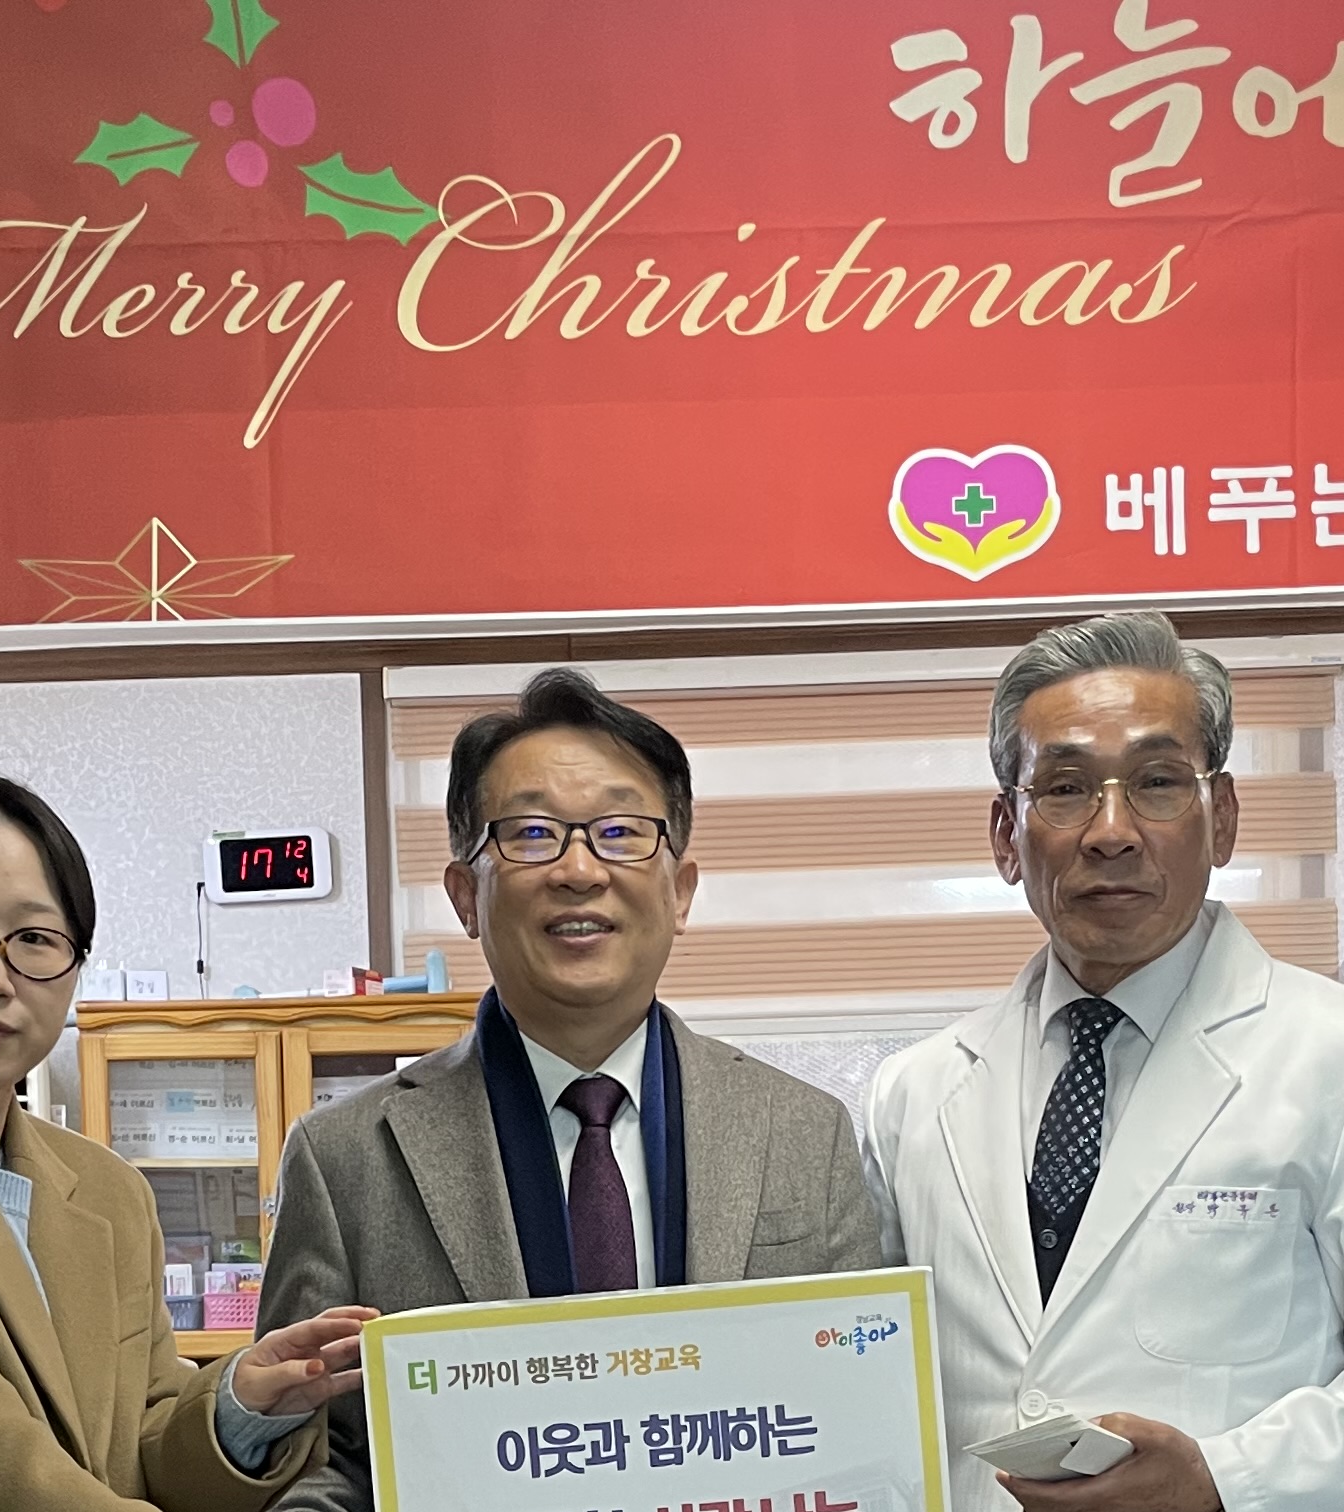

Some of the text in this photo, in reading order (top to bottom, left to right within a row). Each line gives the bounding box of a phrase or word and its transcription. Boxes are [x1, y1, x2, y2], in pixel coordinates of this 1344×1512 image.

[396, 132, 1198, 353] Christmas
[285, 840, 307, 859] 12
[296, 867, 309, 884] 4
[815, 1321, 899, 1355] 아이좋아
[408, 1343, 702, 1395] 더 가까이 행복한 거창교육
[496, 1404, 818, 1479] 이웃과 함께하는
